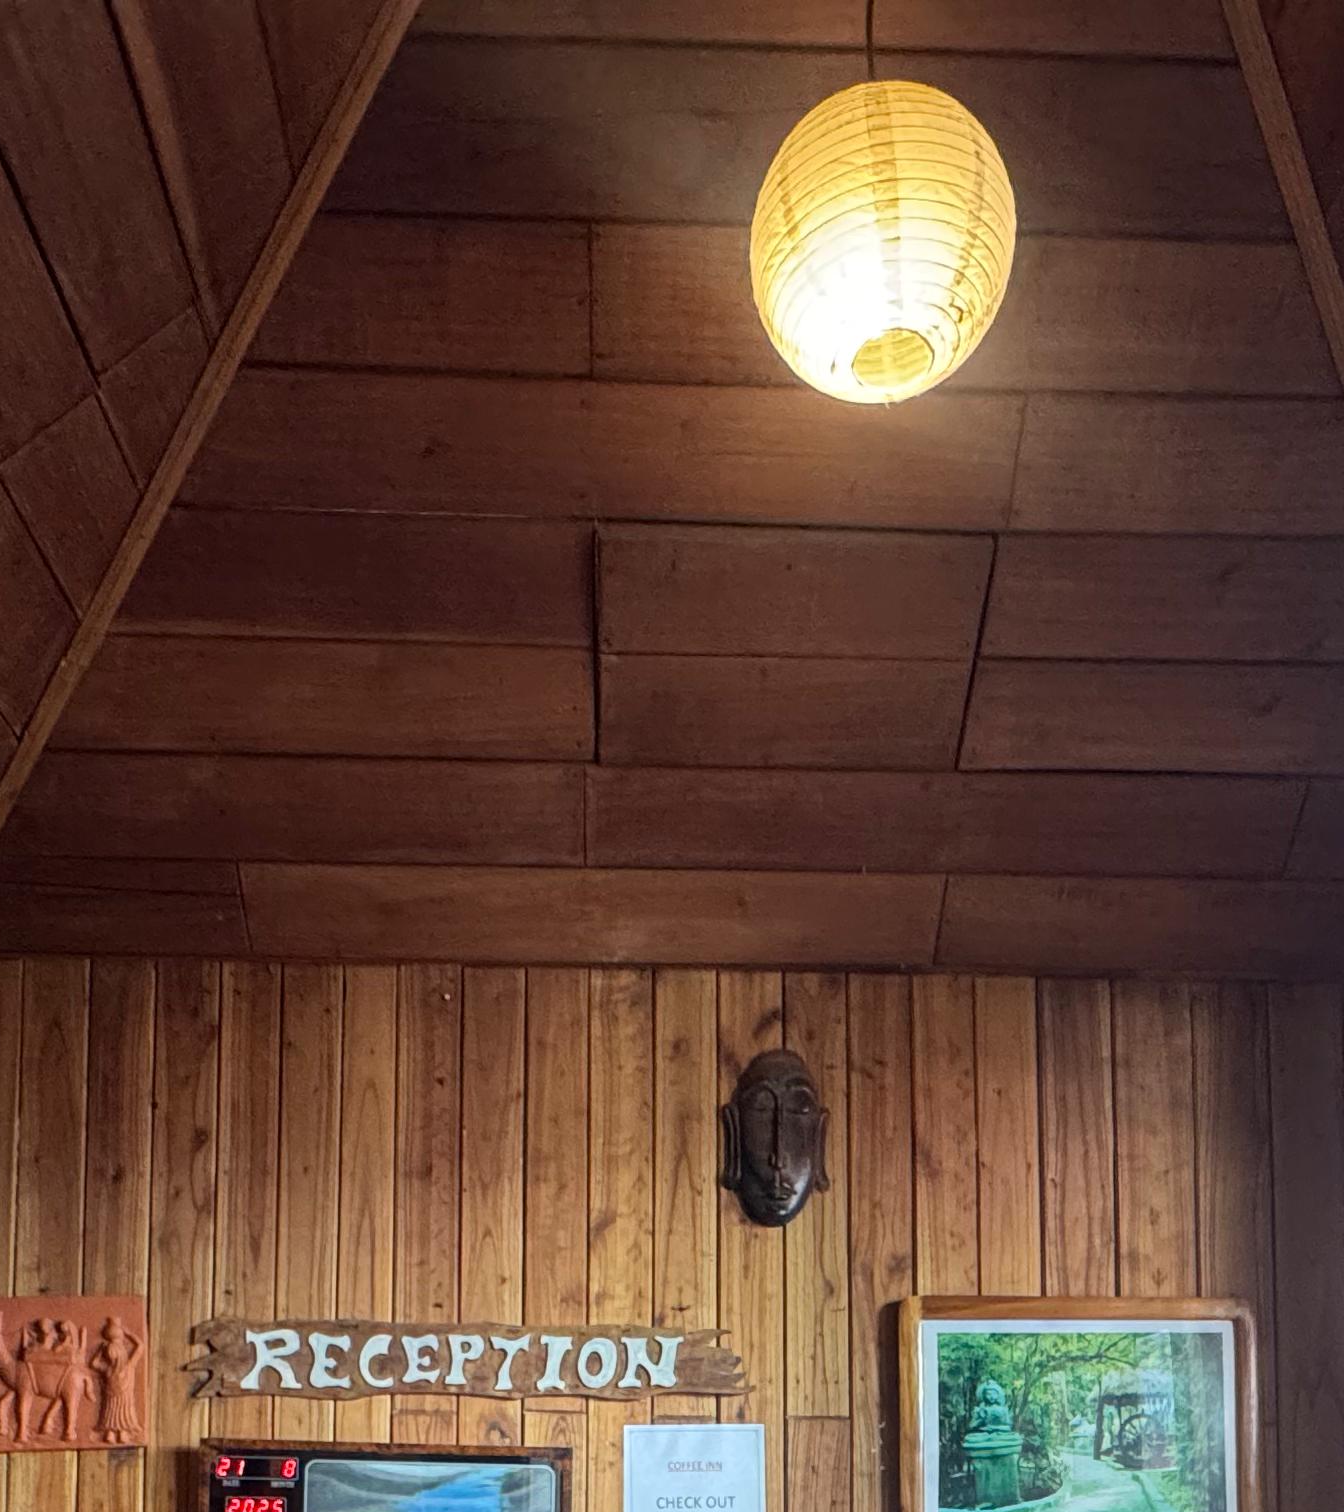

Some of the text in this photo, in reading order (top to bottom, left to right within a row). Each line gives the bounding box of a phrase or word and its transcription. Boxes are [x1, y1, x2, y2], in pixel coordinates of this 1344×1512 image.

[239, 1328, 684, 1392] RECEPTION
[217, 1456, 297, 1478] 21 8
[656, 1495, 736, 1509] CHECK OUT
